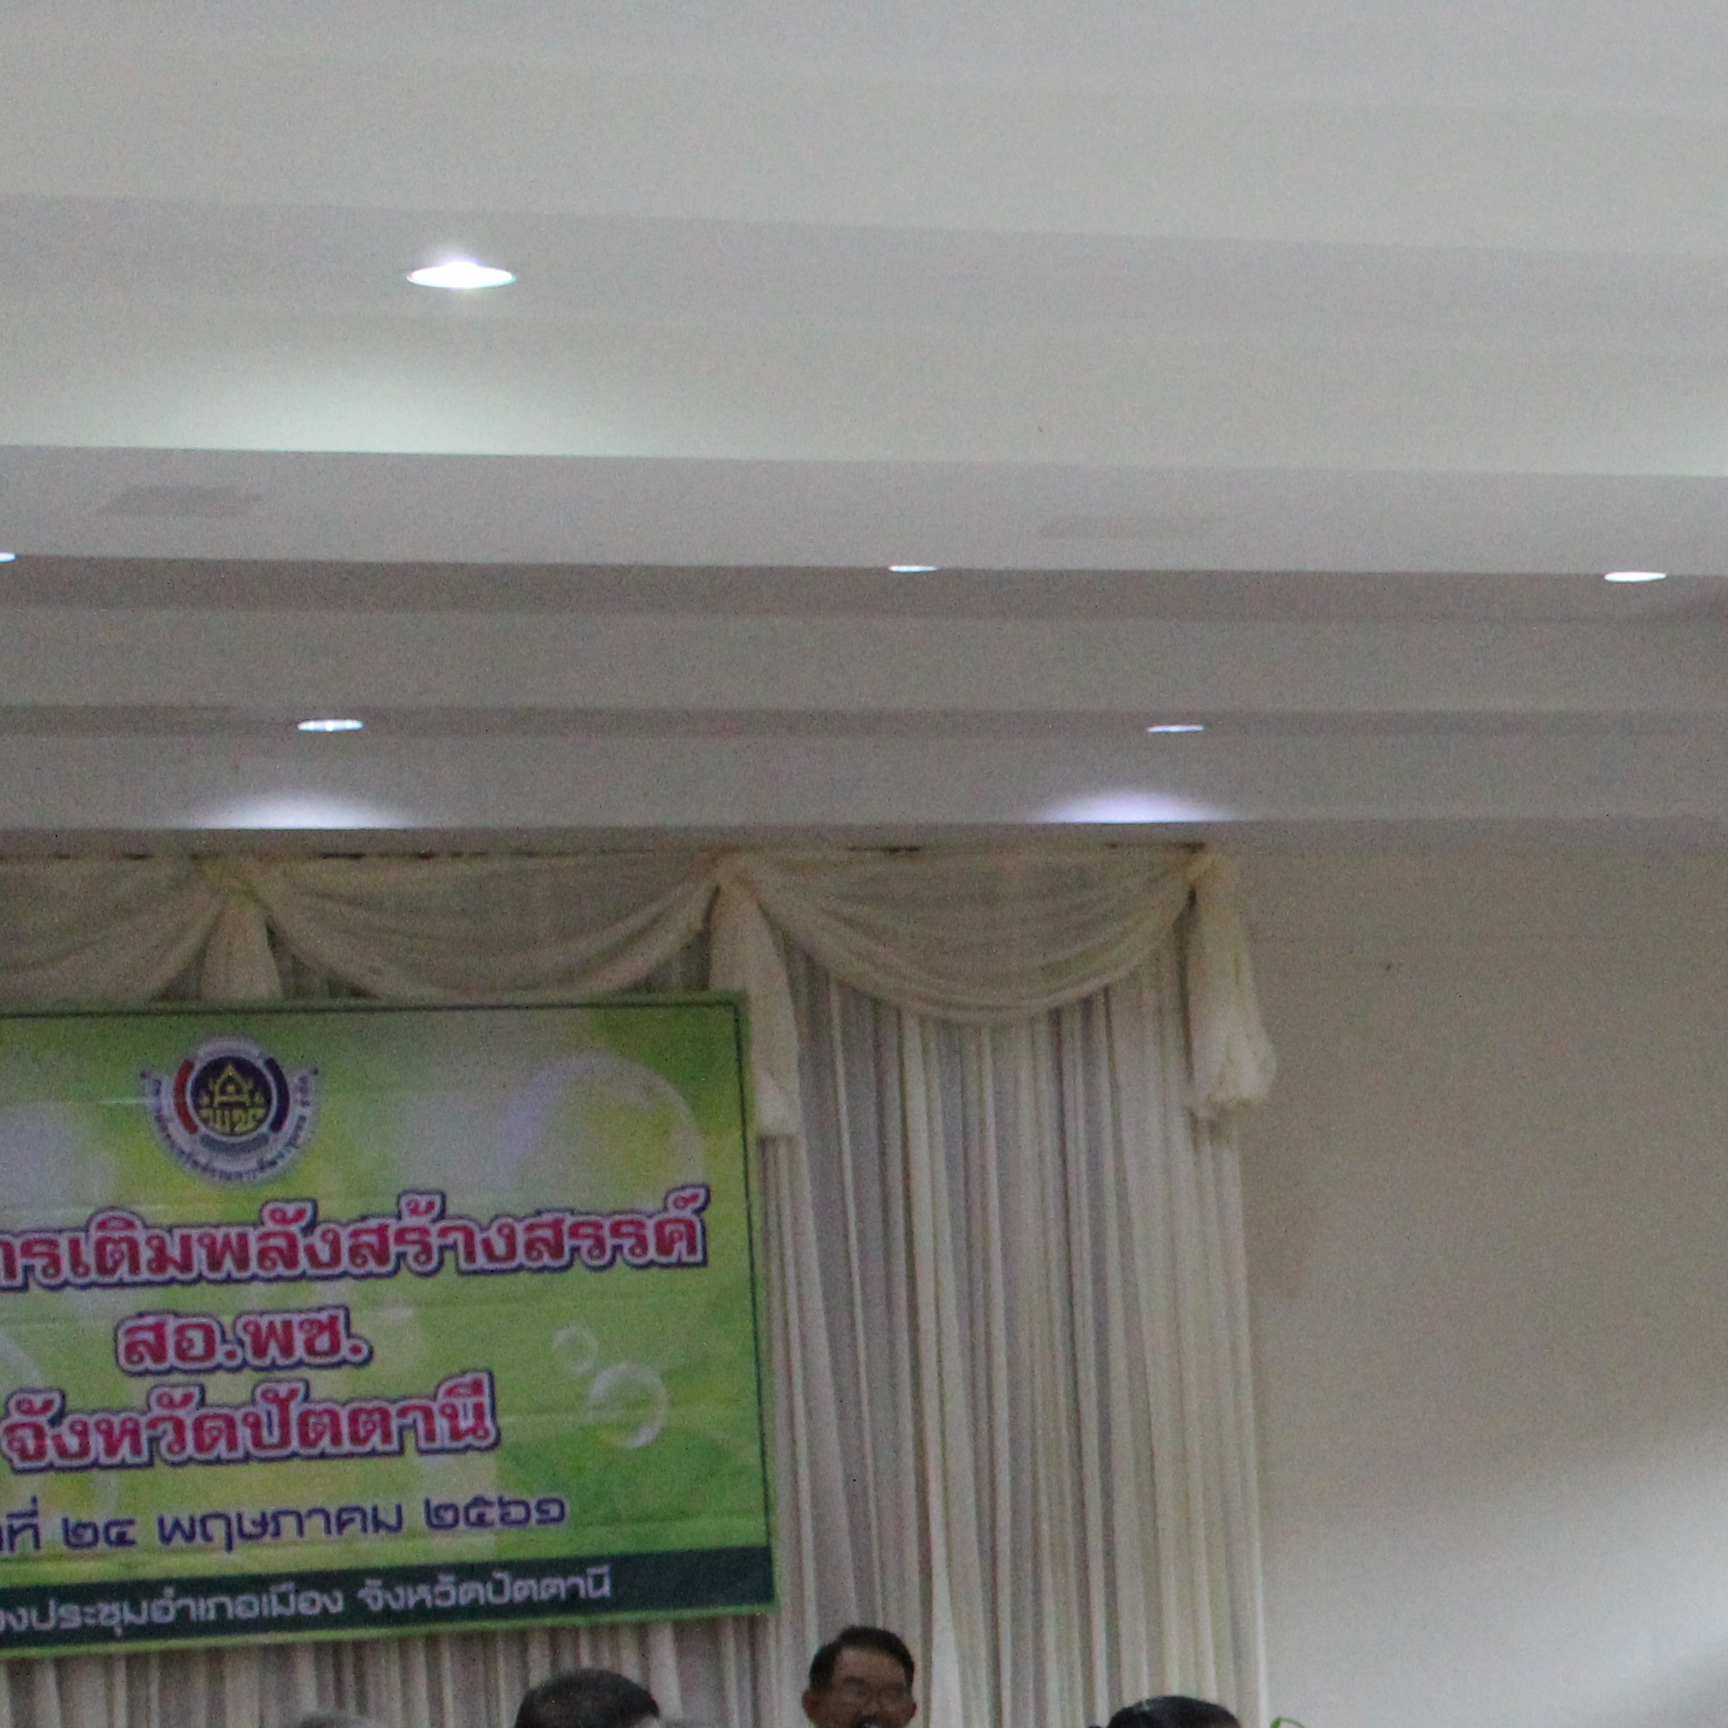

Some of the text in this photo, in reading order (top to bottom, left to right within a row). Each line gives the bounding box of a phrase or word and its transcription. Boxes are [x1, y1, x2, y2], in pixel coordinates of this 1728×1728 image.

[117, 1305, 373, 1376] สอ.พช.
[2, 1371, 501, 1474] จังหวัดปัตตานี
[0, 1495, 567, 1555] ที่ ๒๔ พฤษภาคม ๒๕๖๑
[0, 1566, 611, 1637] งประชุมอำเภอเมือง จังหวัดปัตตานี
